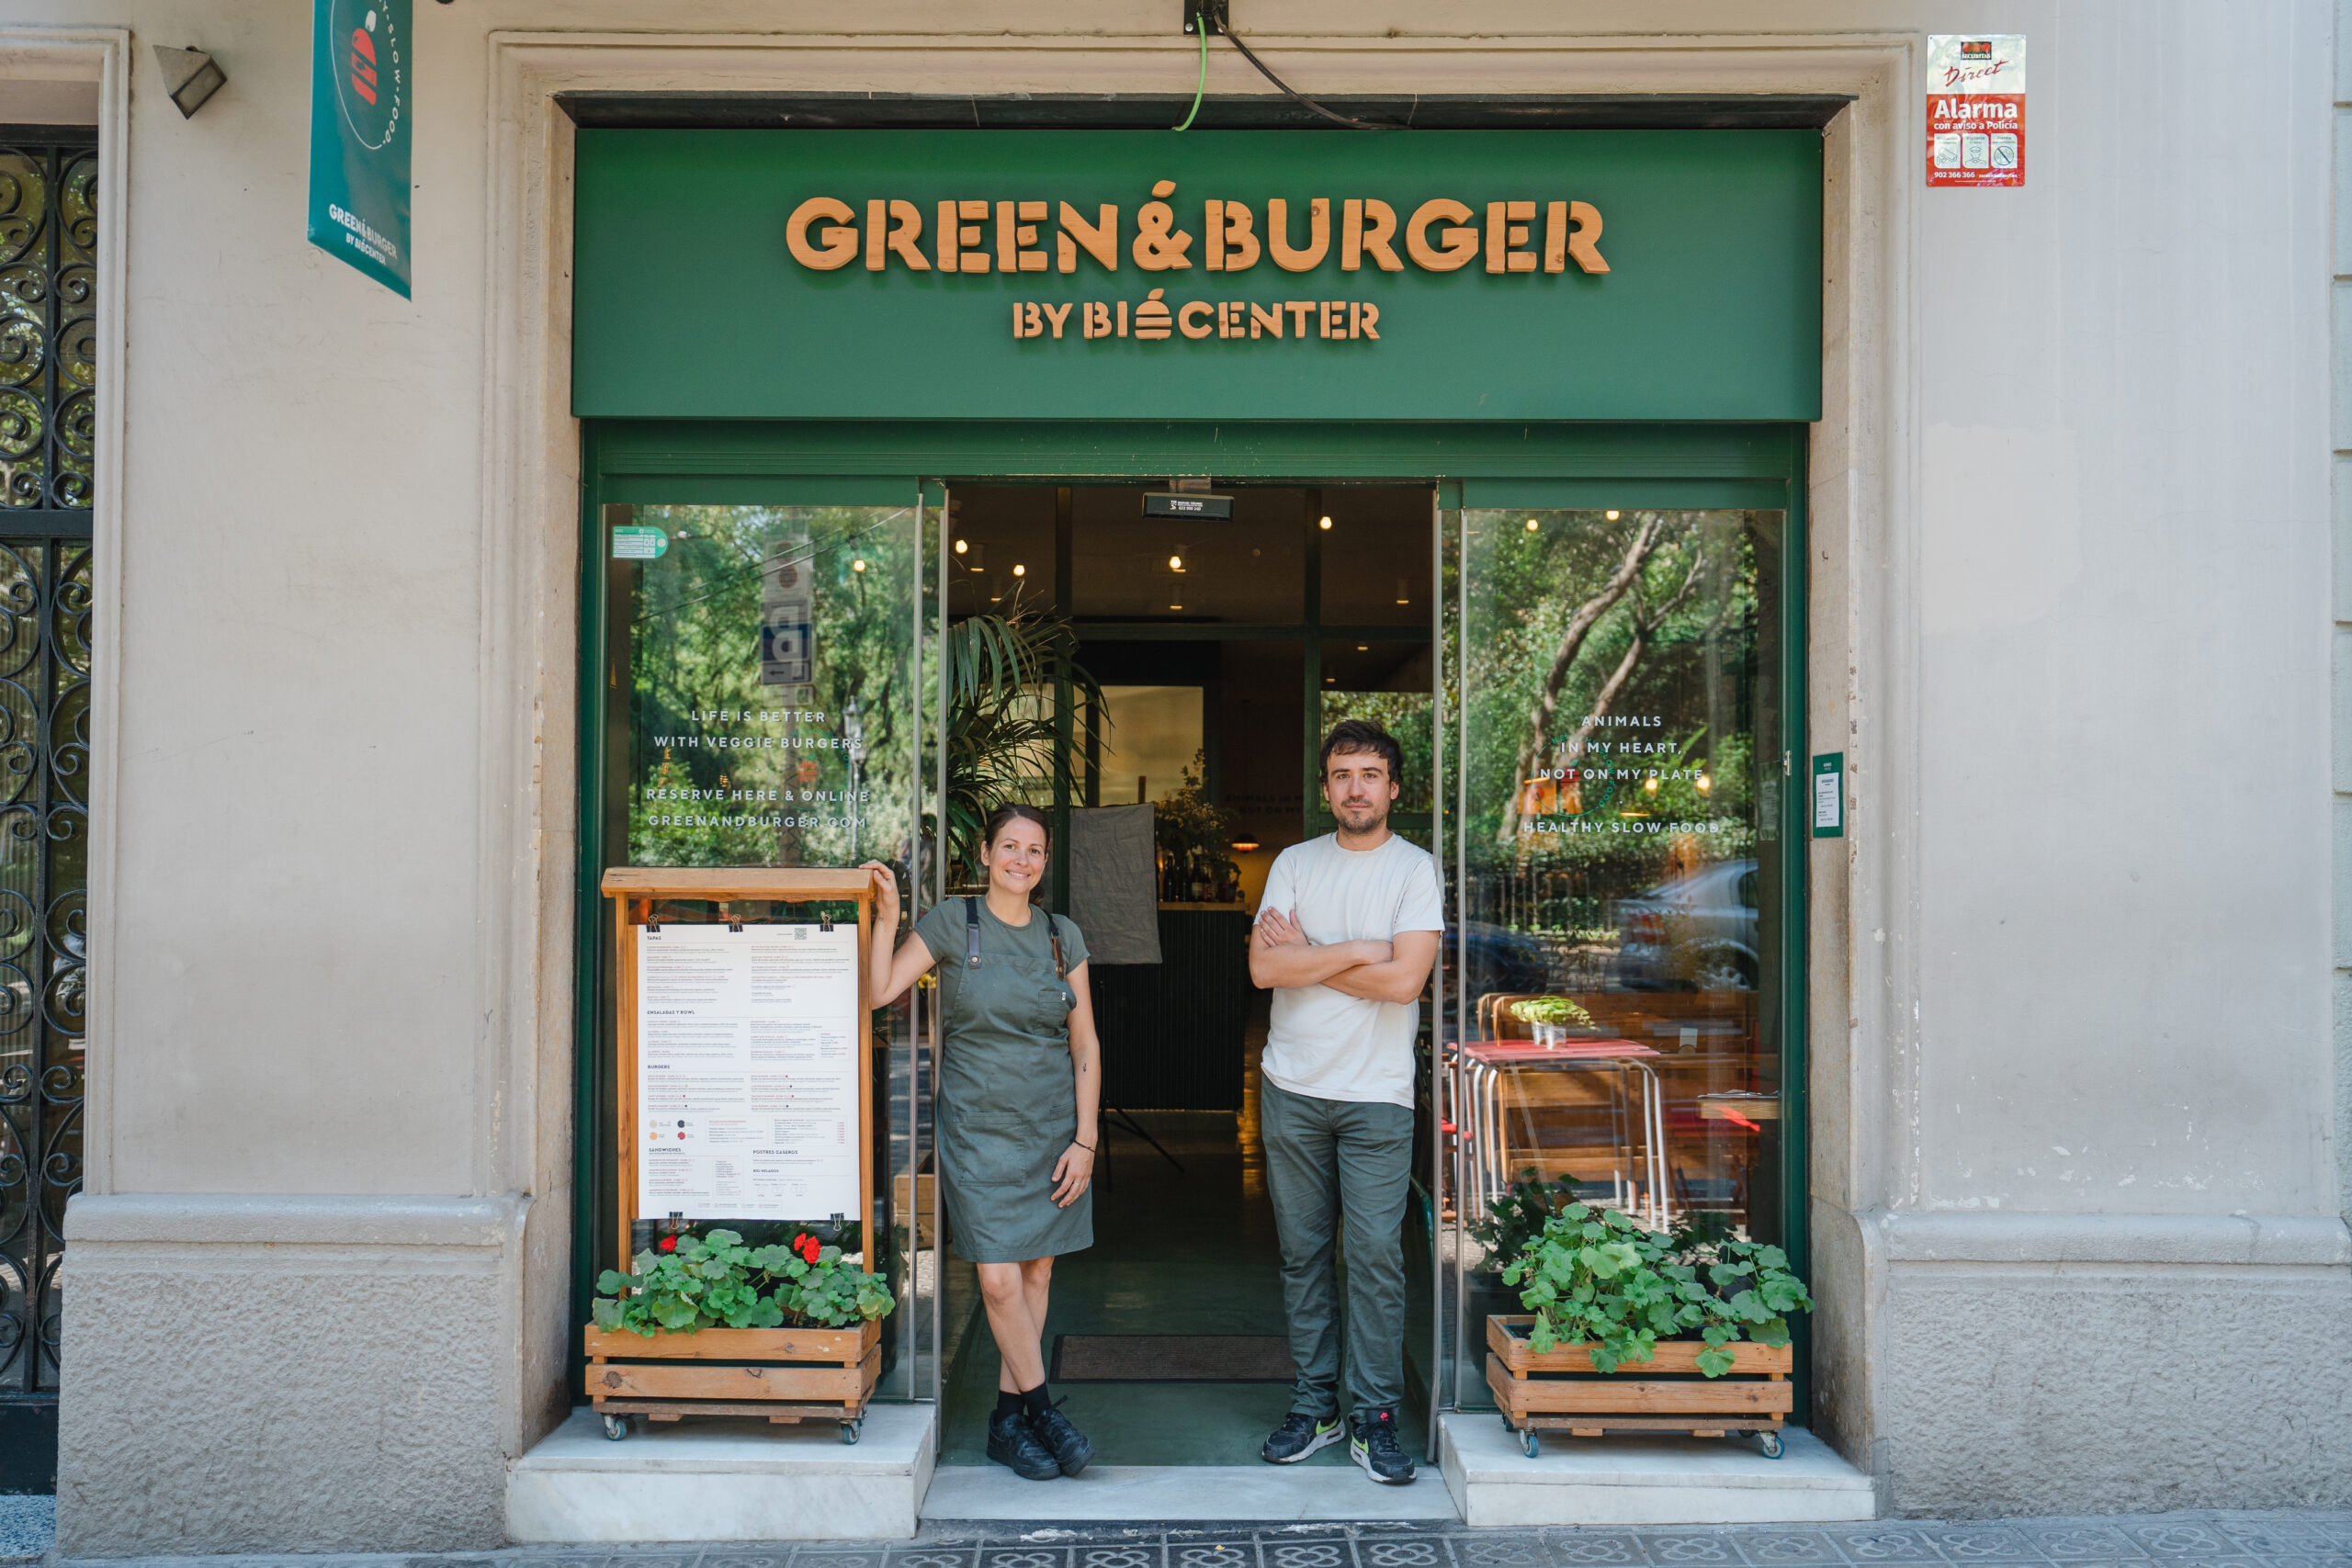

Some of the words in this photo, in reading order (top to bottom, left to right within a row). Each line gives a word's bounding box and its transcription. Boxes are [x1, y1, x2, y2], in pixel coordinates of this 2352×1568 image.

[1943, 58, 2009, 87] Direct
[1934, 97, 2018, 119] Alarma
[1934, 122, 1951, 130] con
[1952, 119, 1977, 130] aviso
[1986, 119, 2018, 130] Policía
[345, 232, 355, 245] BY
[1013, 301, 1073, 340] BY
[691, 710, 729, 723] LIFE
[737, 710, 752, 723] IS
[759, 710, 826, 723] BETTER
[1580, 715, 1663, 728] ANIMALS
[653, 736, 700, 749] WITH
[707, 736, 773, 750] VEGGIE
[780, 737, 863, 750] BURGERS
[1560, 741, 1579, 754] IN
[1586, 741, 1612, 754] MY
[1620, 741, 1683, 756] HEART,
[1539, 768, 1577, 781] NOT
[1583, 768, 1609, 781] ON
[1616, 768, 1641, 781] MY
[1649, 768, 1704, 781] PLATE
[646, 788, 724, 801] RESERVE
[732, 789, 778, 802] HERE
[785, 790, 796, 802] &
[801, 790, 870, 803] ONLINE
[1522, 821, 1605, 834] HEALTHY
[1611, 821, 1662, 834] SLOW
[1668, 821, 1721, 834] FOOD
